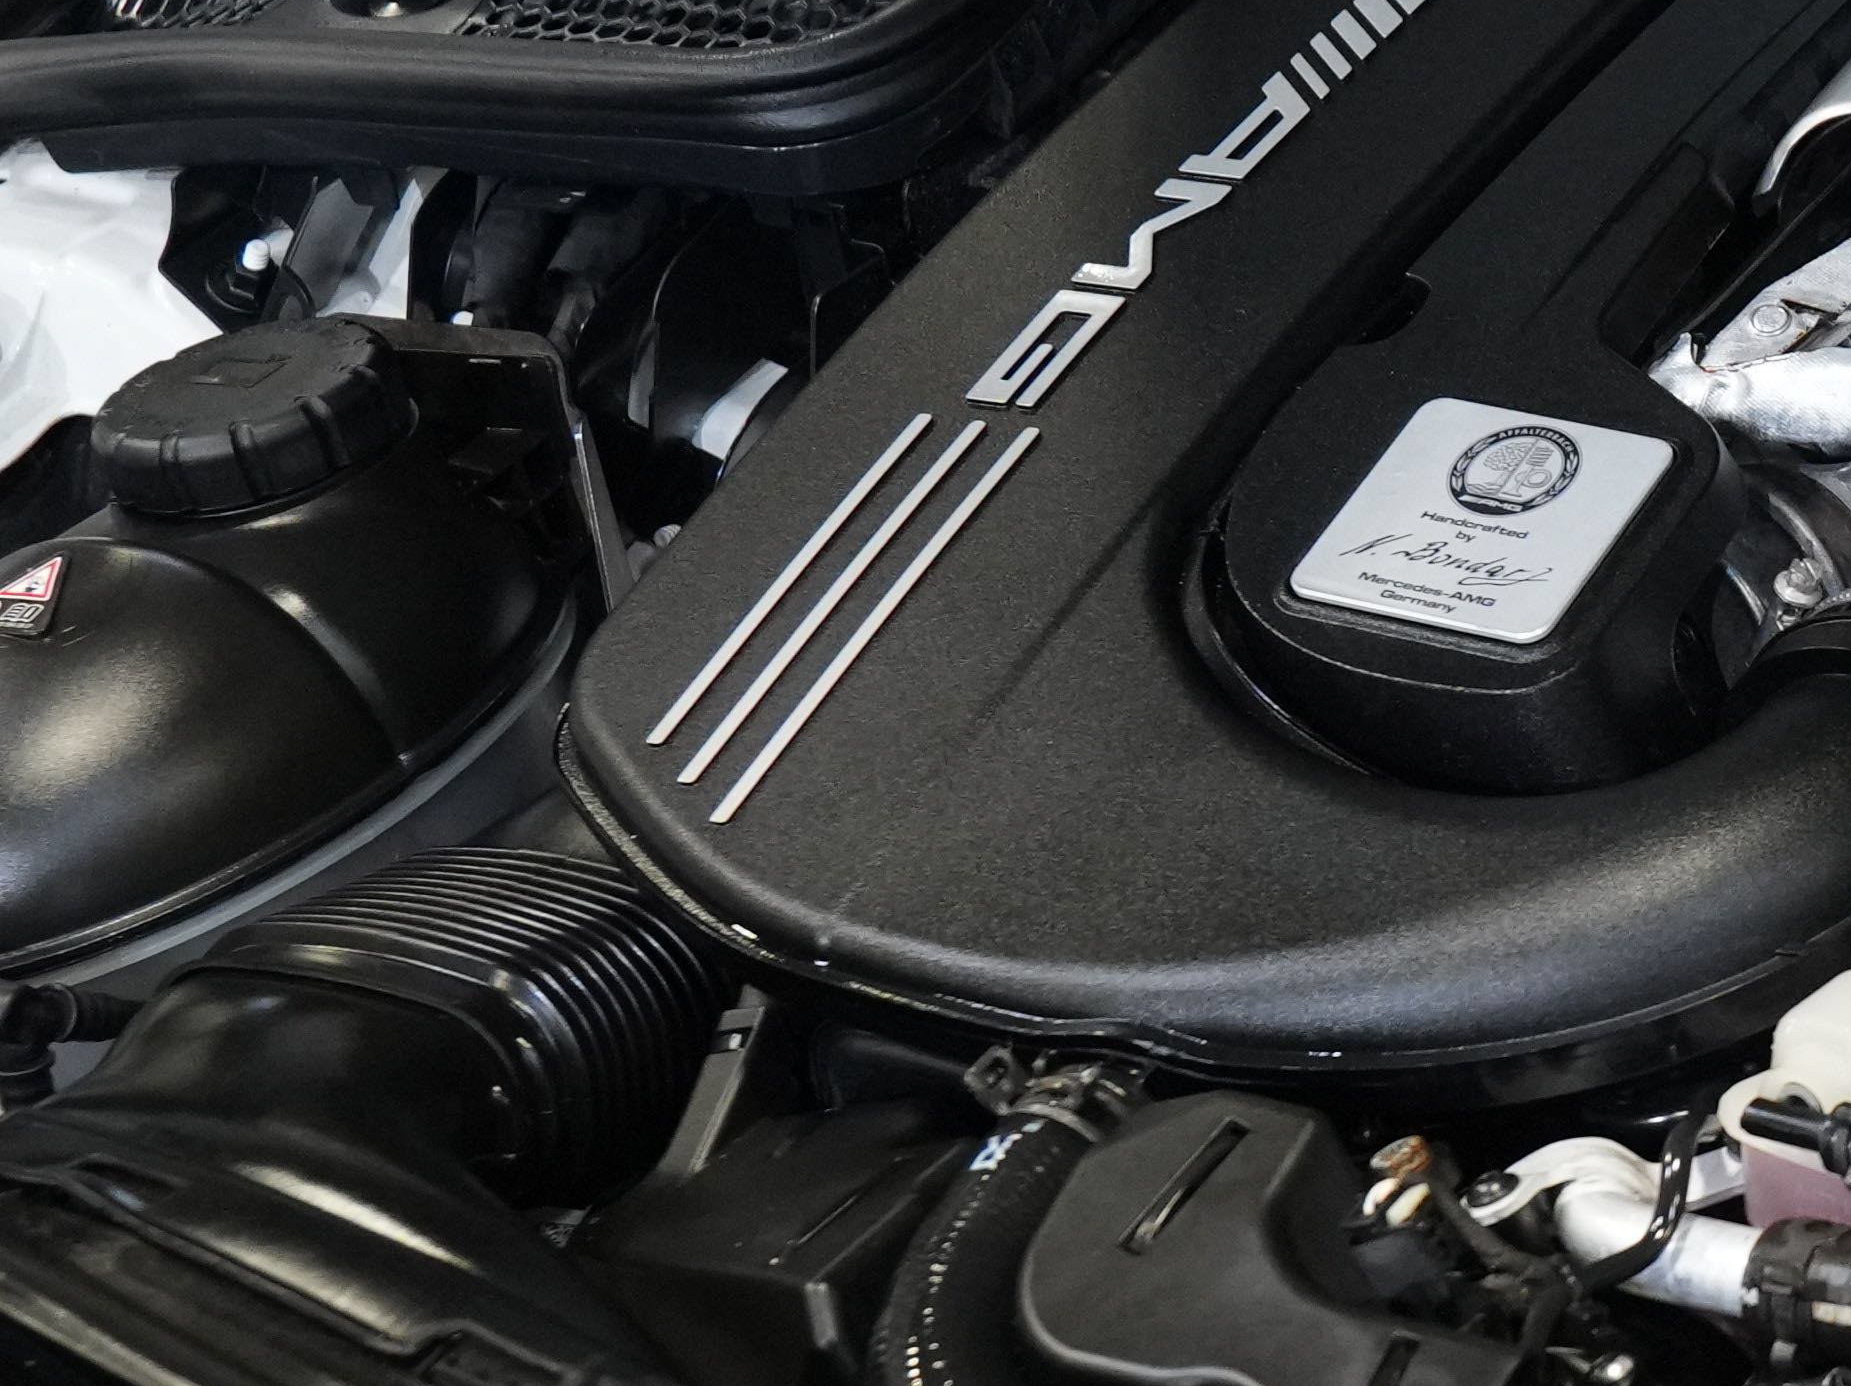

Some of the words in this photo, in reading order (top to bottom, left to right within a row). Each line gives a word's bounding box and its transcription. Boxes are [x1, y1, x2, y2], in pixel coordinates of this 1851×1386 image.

[966, 70, 1311, 409] AMG
[1420, 510, 1530, 540] Handcrafted
[1455, 530, 1477, 543] by
[1357, 571, 1497, 608] Mercedes-AMG
[1380, 589, 1457, 614] Germany
